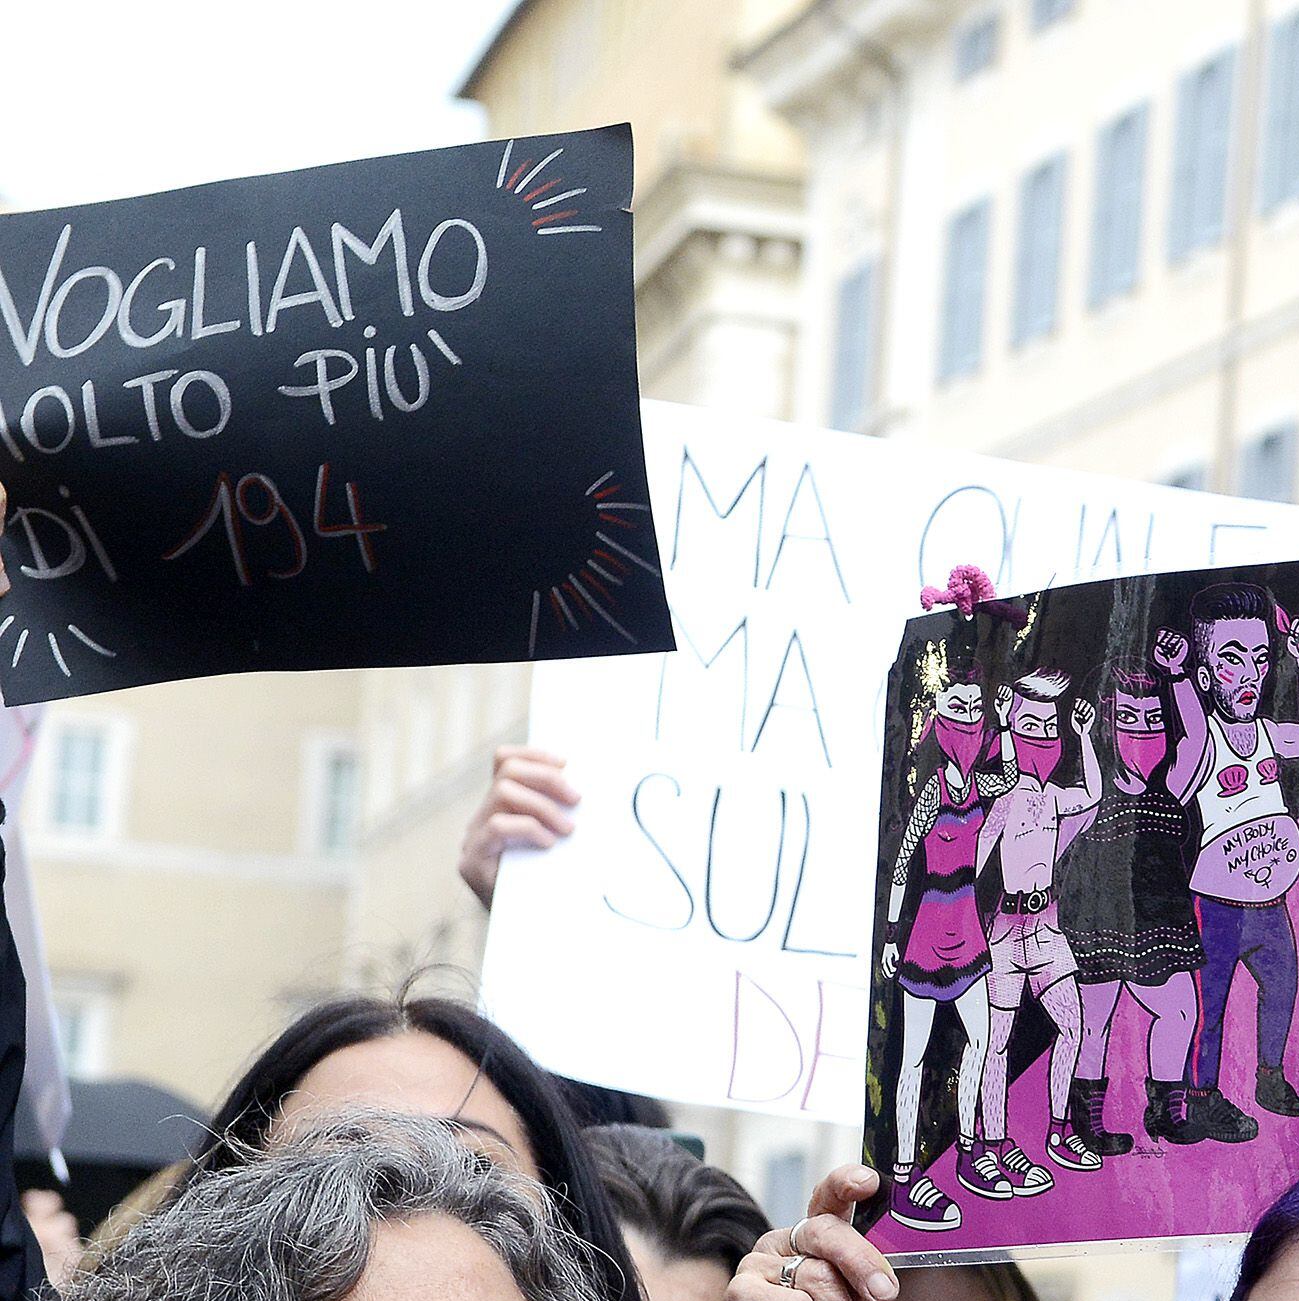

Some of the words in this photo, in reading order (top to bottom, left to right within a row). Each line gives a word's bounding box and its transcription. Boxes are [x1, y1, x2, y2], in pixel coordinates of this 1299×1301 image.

[0, 208, 488, 366] VOGLIAMO
[0, 369, 232, 462] OLTO
[162, 462, 387, 586] 194
[670, 444, 850, 603] MA
[655, 600, 832, 768] MA
[602, 772, 857, 958] SUL
[1222, 832, 1243, 856] MY
[1228, 849, 1249, 874] MY
